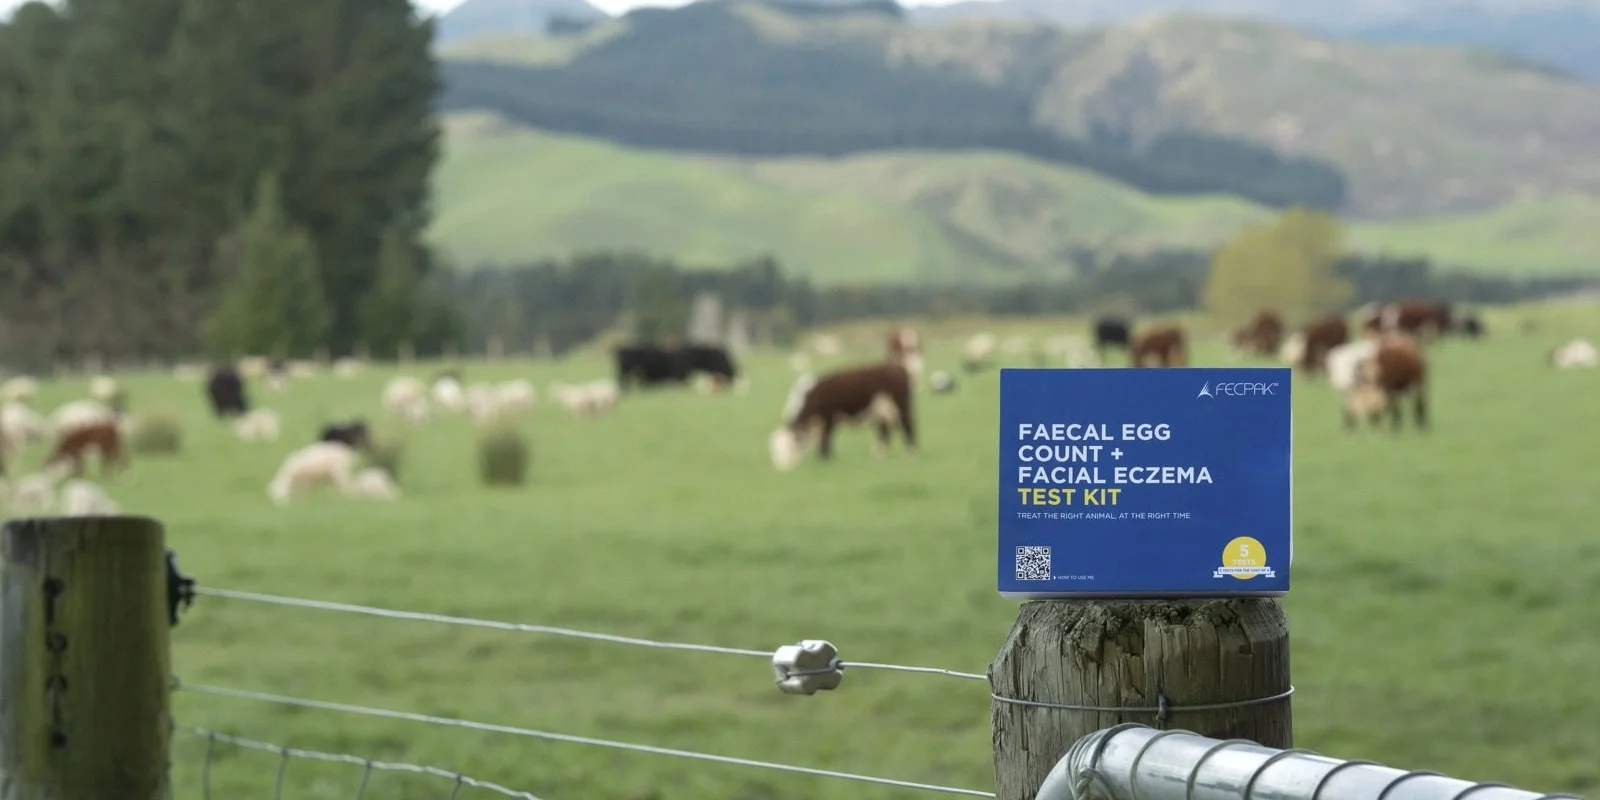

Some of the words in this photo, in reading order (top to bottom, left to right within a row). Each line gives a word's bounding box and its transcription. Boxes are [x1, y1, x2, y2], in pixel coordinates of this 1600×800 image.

[1018, 424, 1114, 441] FAECAL
[1122, 424, 1171, 440] EGG
[1018, 445, 1103, 462] COUNT
[1110, 447, 1124, 460] +
[1018, 467, 1106, 484] FACIAL
[1114, 467, 1213, 484] ECZEMA
[1018, 488, 1076, 505] TEST
[1085, 488, 1122, 505] KIT
[1017, 512, 1041, 520] TREAT
[1043, 512, 1059, 520] THE
[1060, 512, 1084, 520] RIGHT
[1118, 512, 1129, 520] AT
[1130, 512, 1146, 520] THE
[1147, 512, 1171, 520] RIGHT
[1172, 512, 1191, 520] TIME
[1239, 544, 1249, 558] 5
